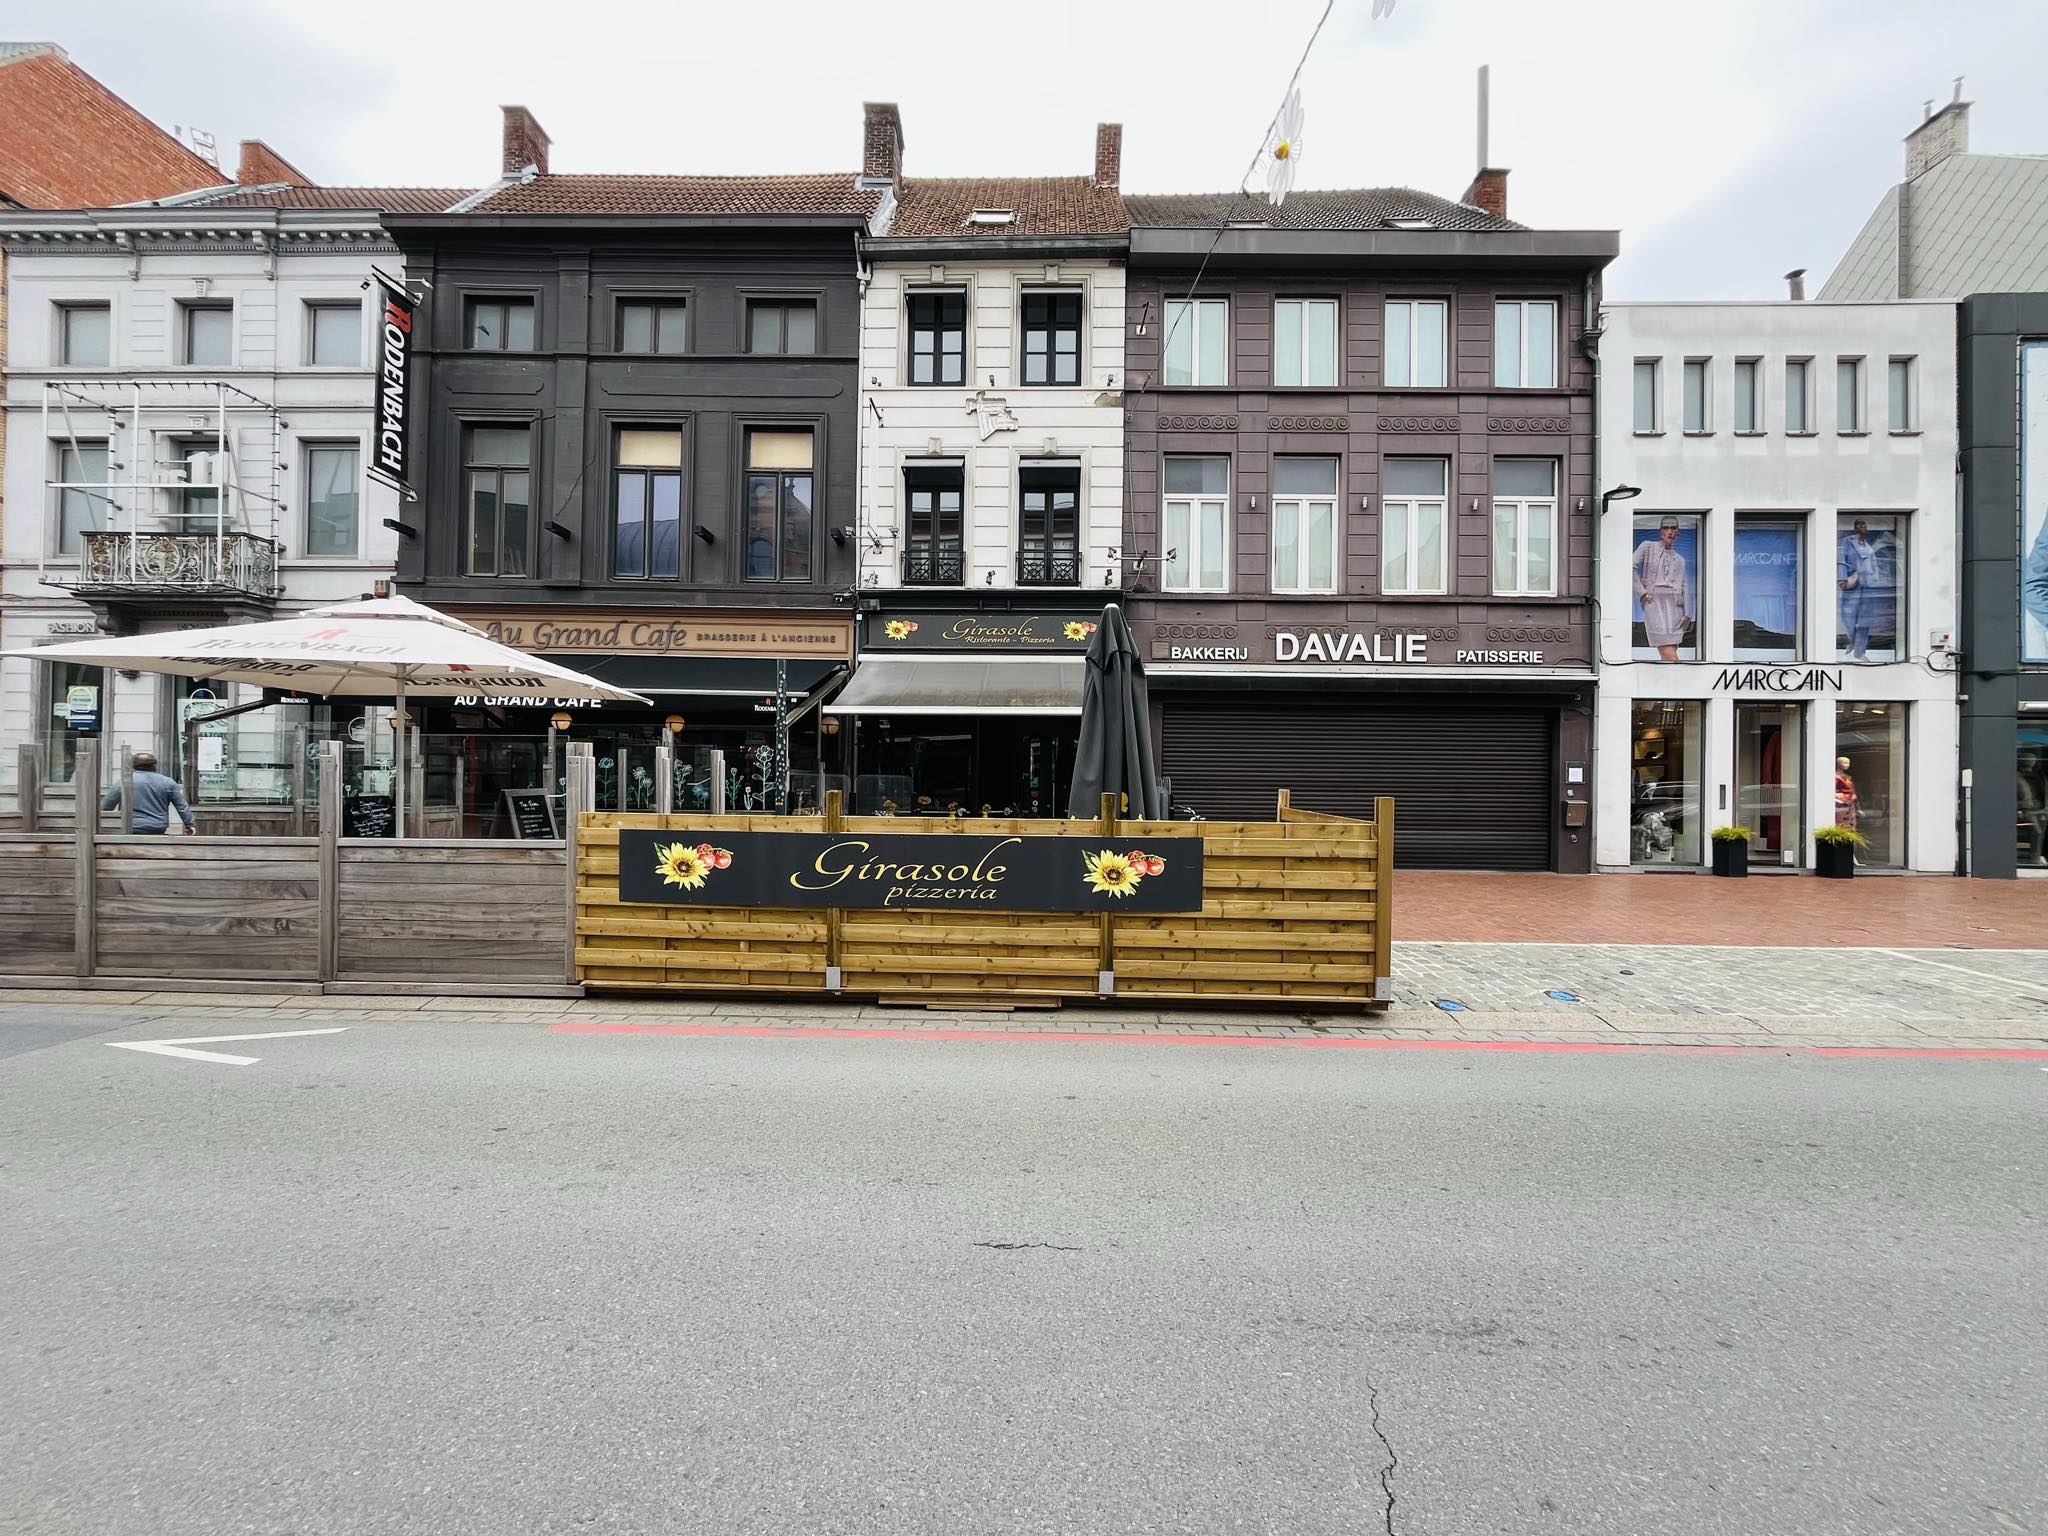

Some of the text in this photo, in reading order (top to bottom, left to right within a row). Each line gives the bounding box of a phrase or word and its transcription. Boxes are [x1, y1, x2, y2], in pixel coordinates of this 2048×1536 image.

[382, 297, 413, 472] RODENBACH
[48, 622, 96, 633] FASHION
[942, 616, 1039, 640] Girasole
[486, 619, 688, 655] Au Grand Cafe
[696, 633, 756, 642] BRASSERIE
[772, 634, 836, 643] L'ANCIENNE
[965, 635, 1011, 644] Ristorante
[1020, 635, 1056, 644] Pizzeria
[190, 638, 409, 655] RODENBACH
[1171, 646, 1248, 660] BAKKERIJ
[1275, 632, 1428, 663] DAVALIE
[1456, 650, 1544, 663] PATISSERIE
[454, 695, 478, 706] AU
[484, 695, 548, 707] GRAND
[789, 837, 1022, 890] Girasole
[883, 883, 998, 906] pizzeria
